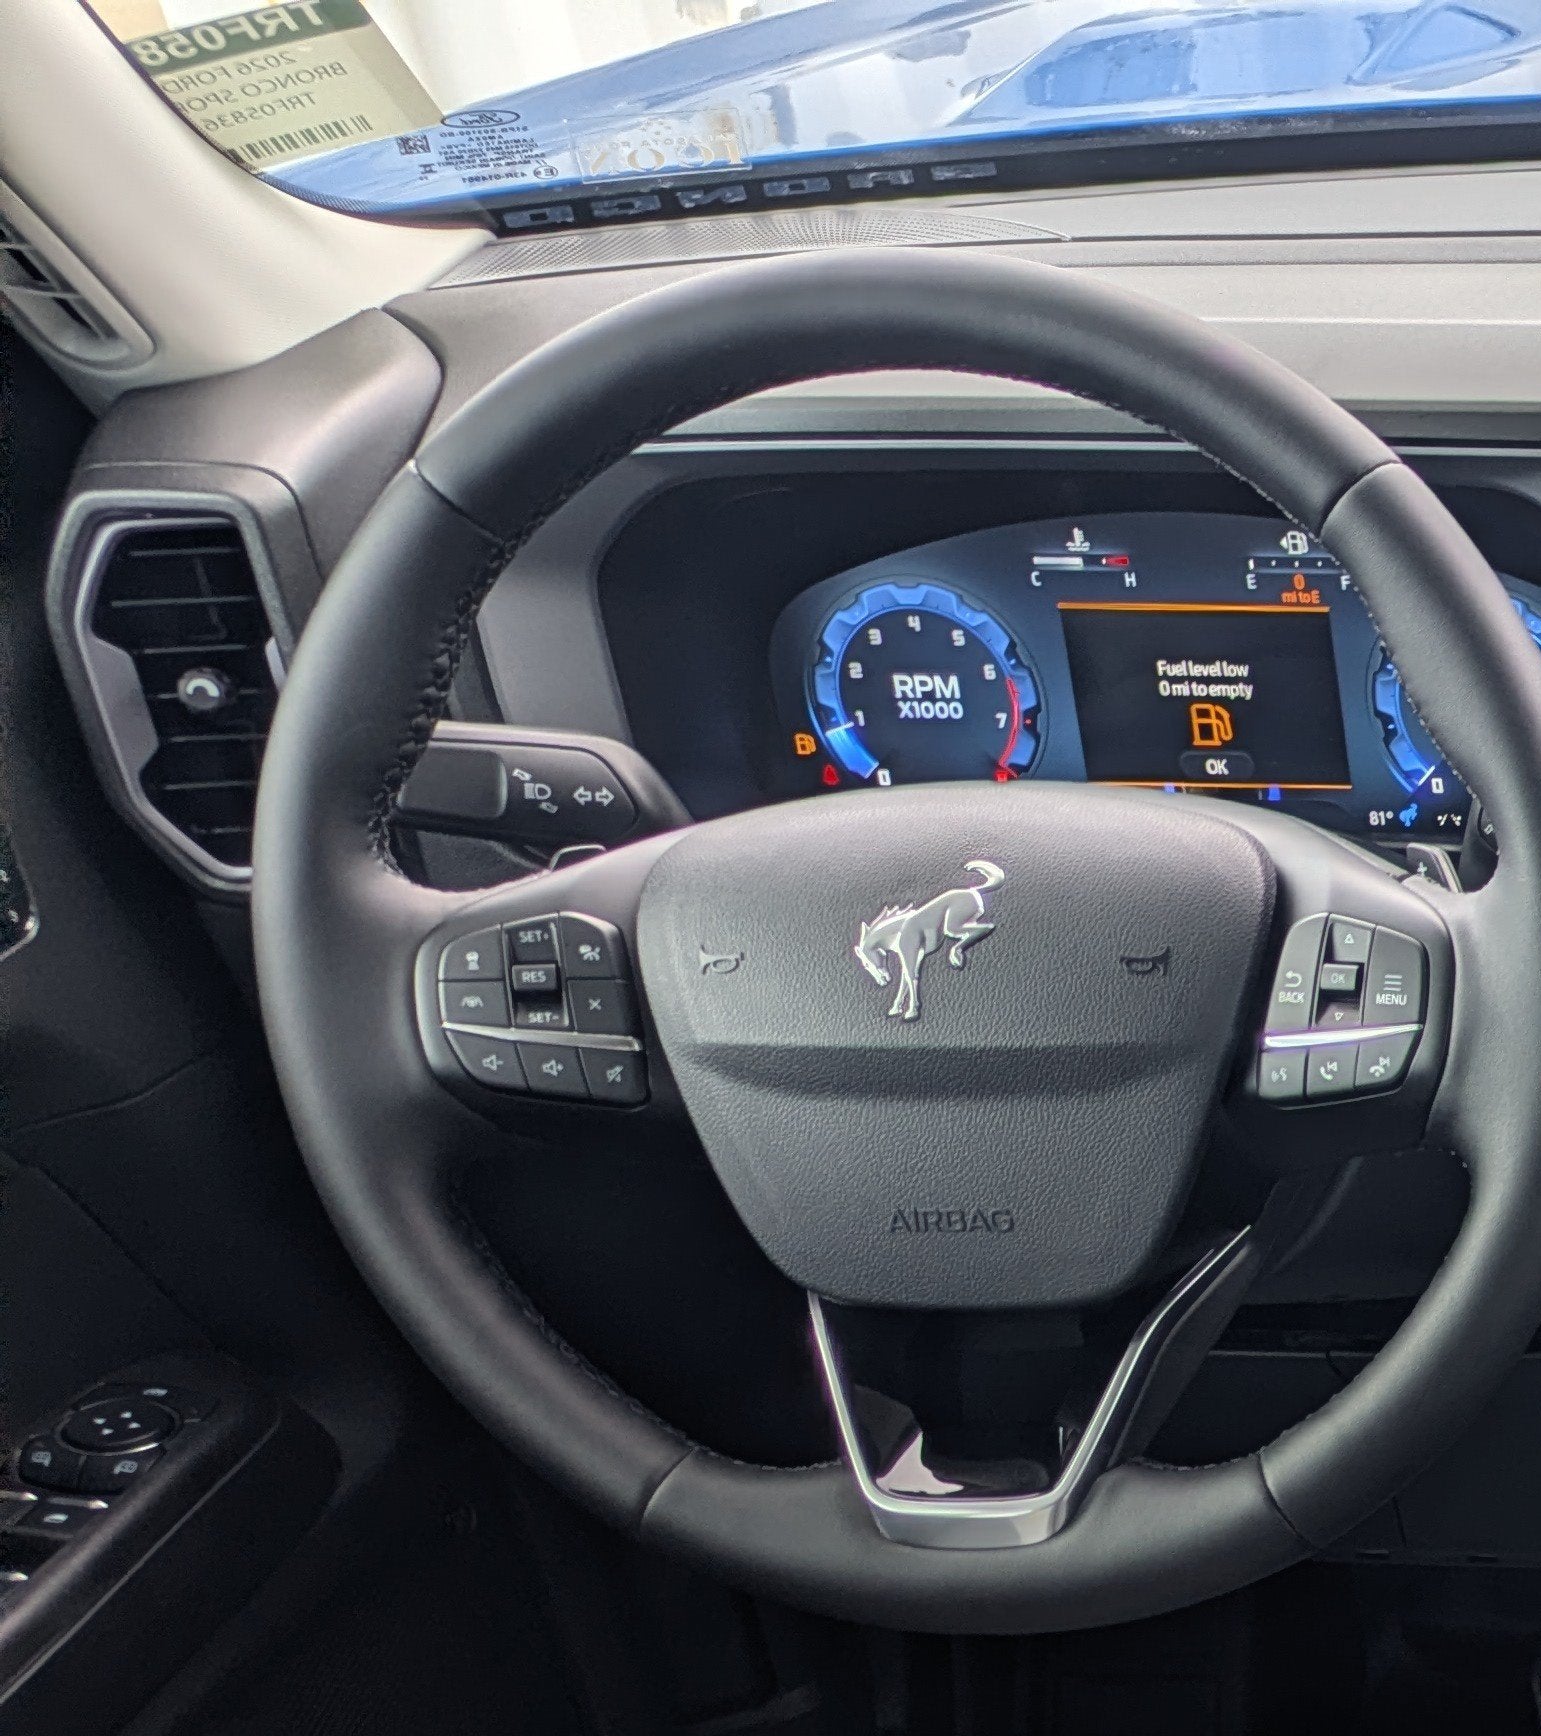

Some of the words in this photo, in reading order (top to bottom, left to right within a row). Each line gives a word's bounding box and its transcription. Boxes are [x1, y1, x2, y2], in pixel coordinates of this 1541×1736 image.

[1031, 572, 1042, 587] C
[1124, 572, 1137, 587] H
[1246, 574, 1257, 590] E
[1340, 575, 1351, 591] F
[907, 615, 922, 632] 4
[868, 629, 883, 646] 3
[951, 629, 966, 647] 5
[848, 662, 864, 679] 2
[983, 664, 997, 681] 6
[1156, 660, 1186, 678] Fuel
[1188, 661, 1222, 678] level
[1223, 661, 1249, 678] low
[892, 673, 961, 699] RPM
[1159, 682, 1170, 697] 0
[1172, 682, 1190, 696] mi
[1191, 683, 1208, 697] to
[1209, 682, 1254, 701] empty
[854, 710, 866, 727] 1
[995, 712, 1008, 729] 7
[1205, 759, 1229, 776] OK
[877, 769, 891, 786] 0
[1431, 777, 1444, 794] 0
[522, 971, 547, 983] RES
[1330, 973, 1346, 984] OK
[1278, 991, 1305, 1004] BACK
[1376, 993, 1408, 1006] MENU
[888, 1209, 1016, 1234] AIRBAG
